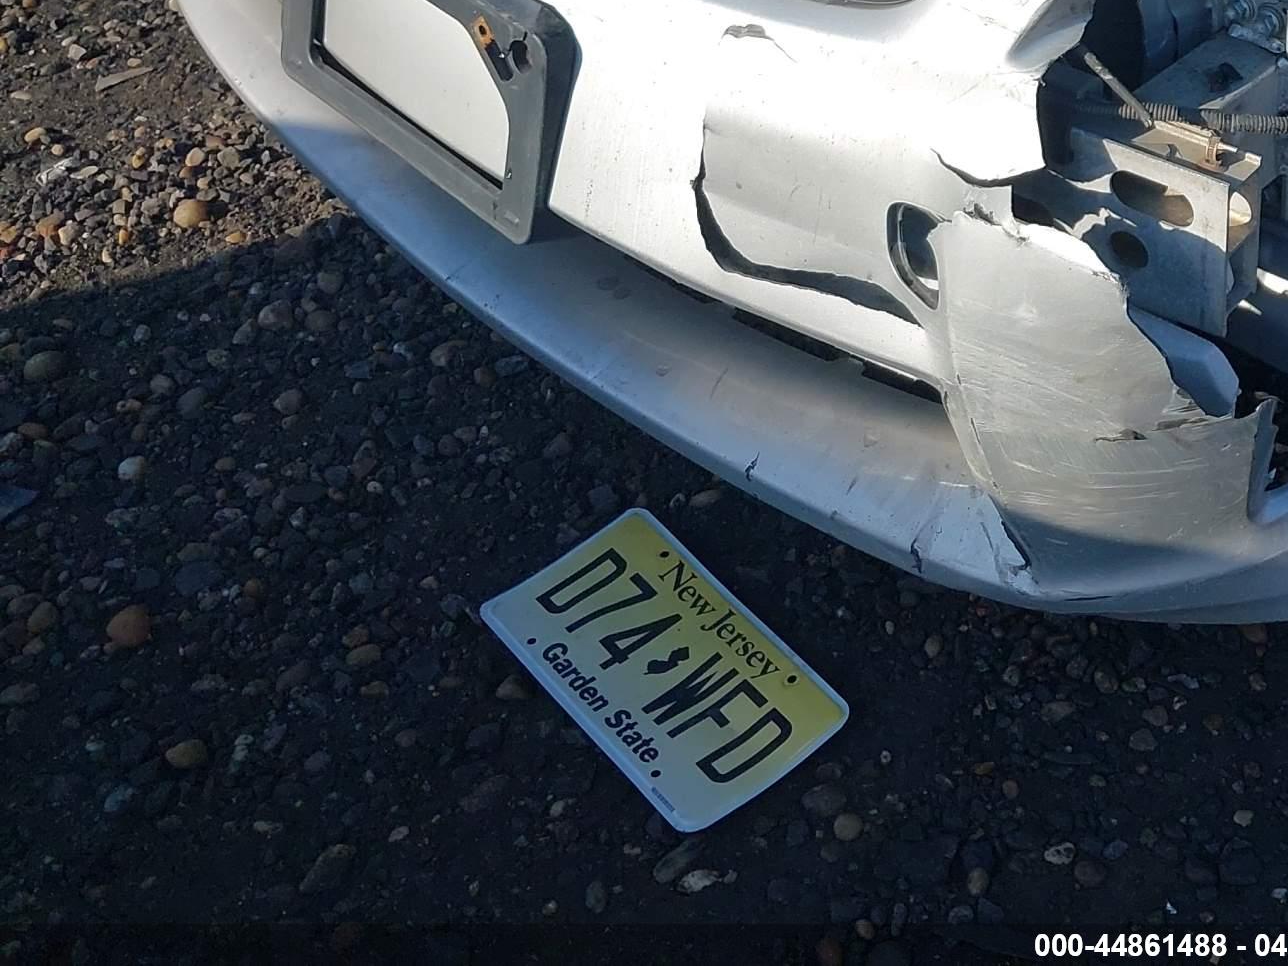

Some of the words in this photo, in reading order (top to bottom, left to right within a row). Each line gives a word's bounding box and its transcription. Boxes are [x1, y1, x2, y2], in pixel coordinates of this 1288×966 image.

[535, 546, 683, 671] D74
[641, 651, 793, 784] WFD
[657, 560, 716, 617] New
[700, 608, 781, 679] Jersey
[541, 642, 609, 713] Garden
[603, 708, 659, 763] State
